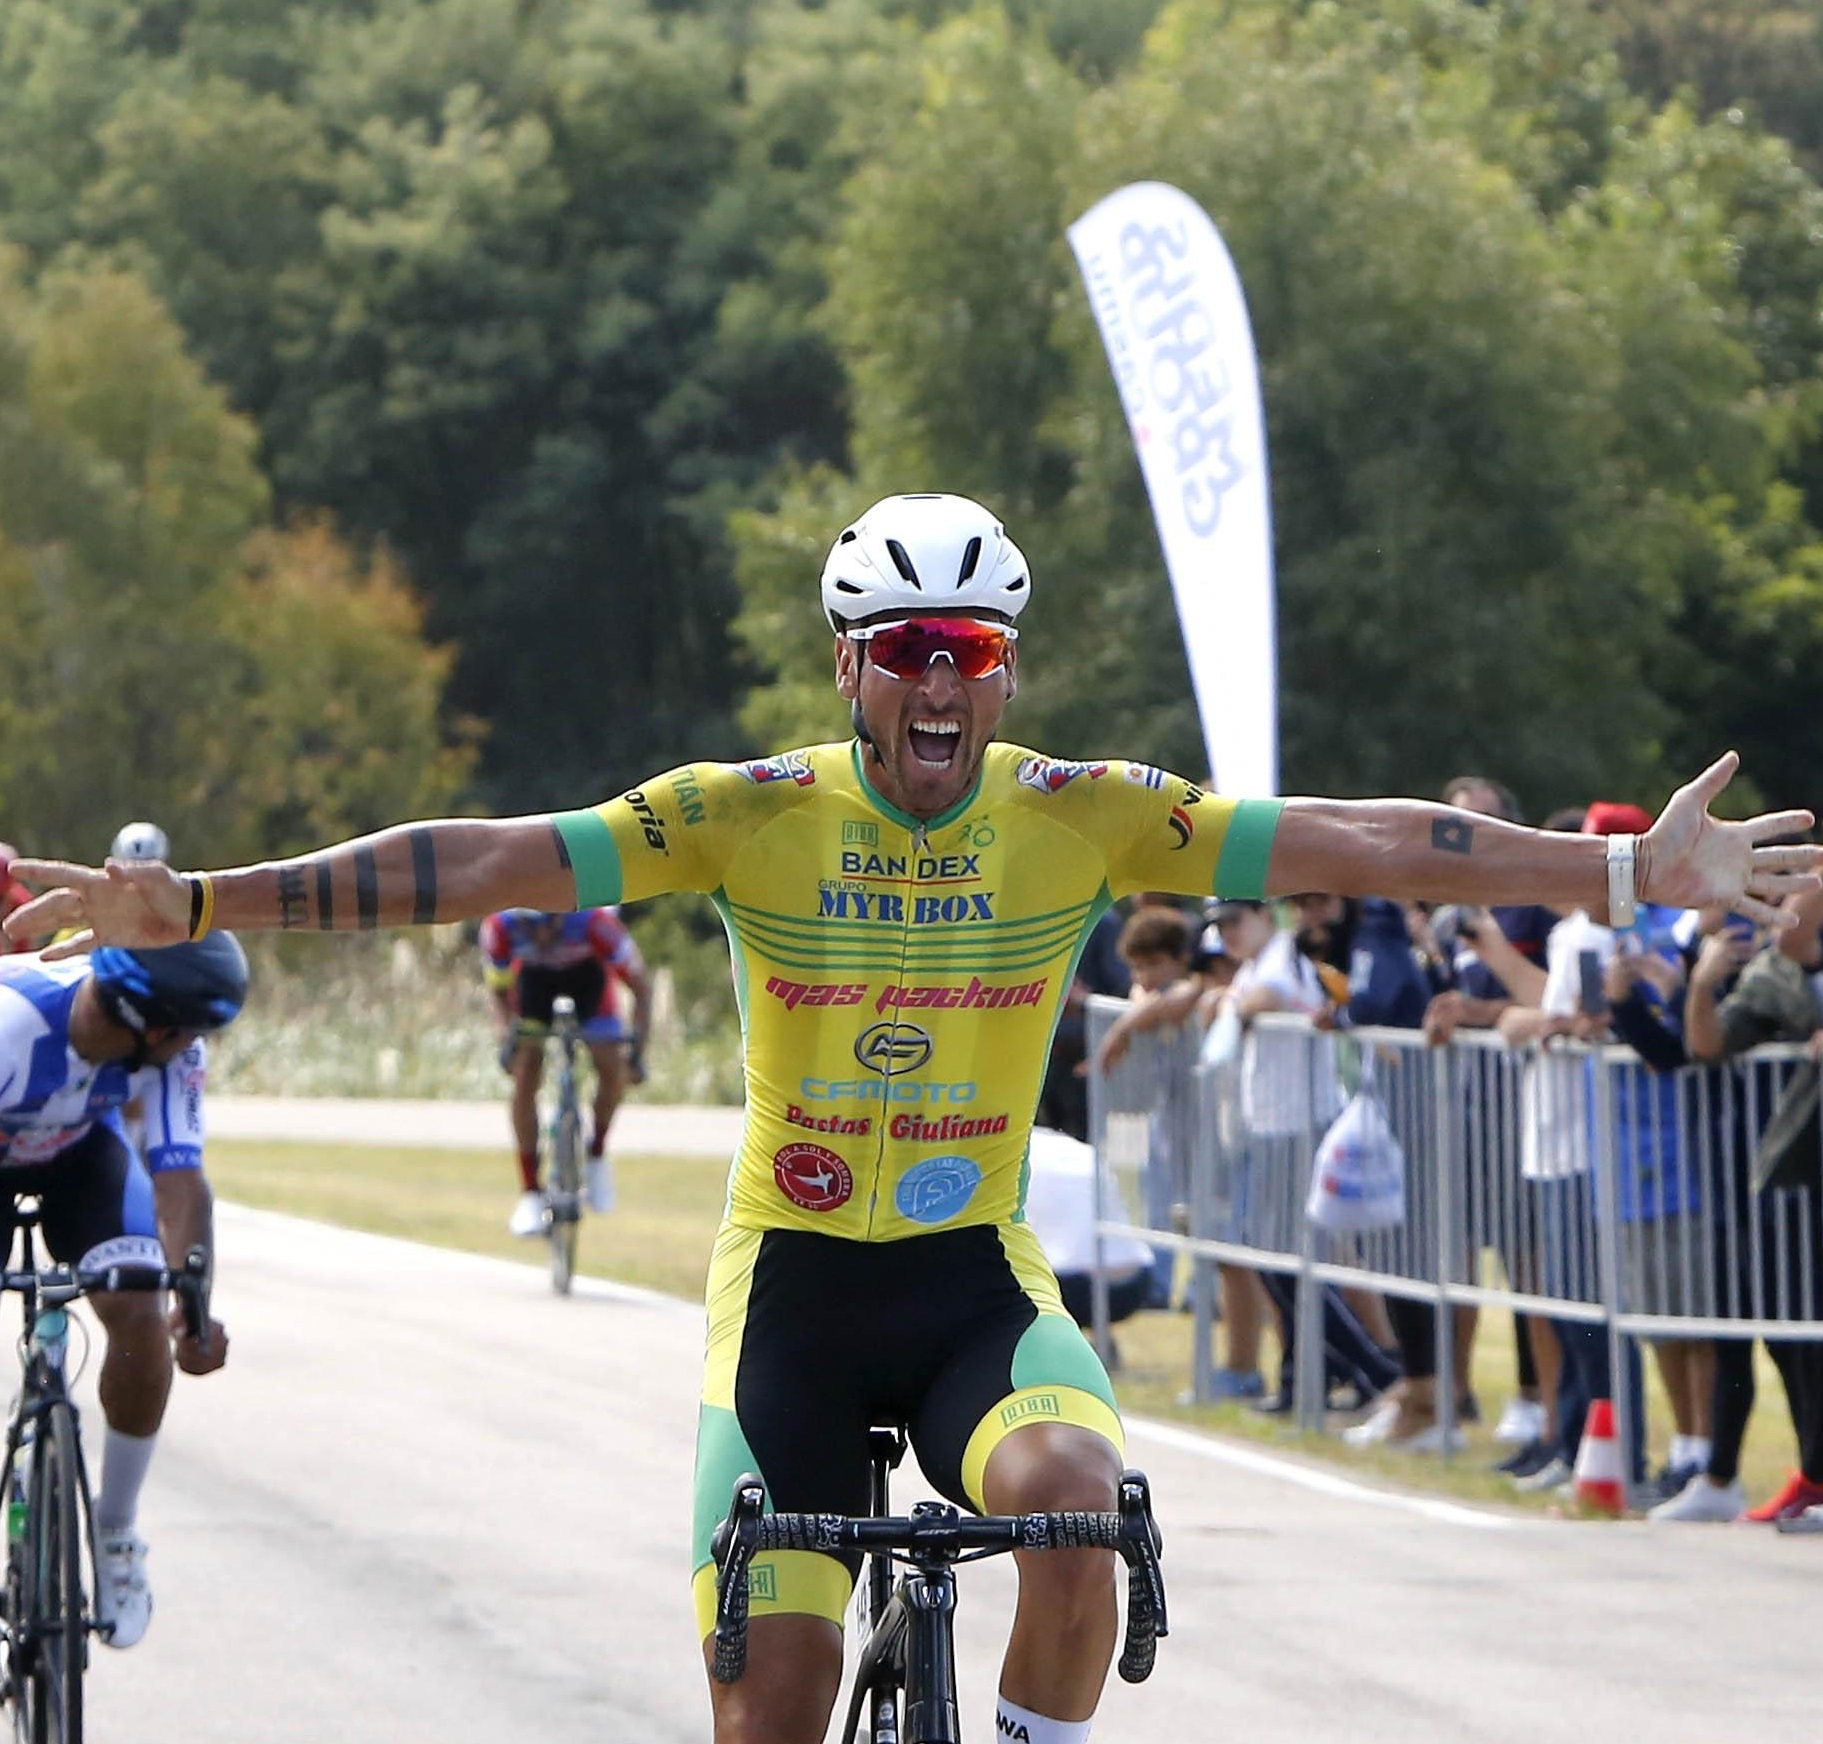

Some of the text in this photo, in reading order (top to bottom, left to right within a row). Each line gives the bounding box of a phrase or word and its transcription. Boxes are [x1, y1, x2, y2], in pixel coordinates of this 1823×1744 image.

[818, 879, 867, 892] GRUPO
[817, 890, 995, 924] MYR BOX
[800, 1078, 979, 1103] CFMOTO
[889, 1113, 1009, 1142] Giuliana
